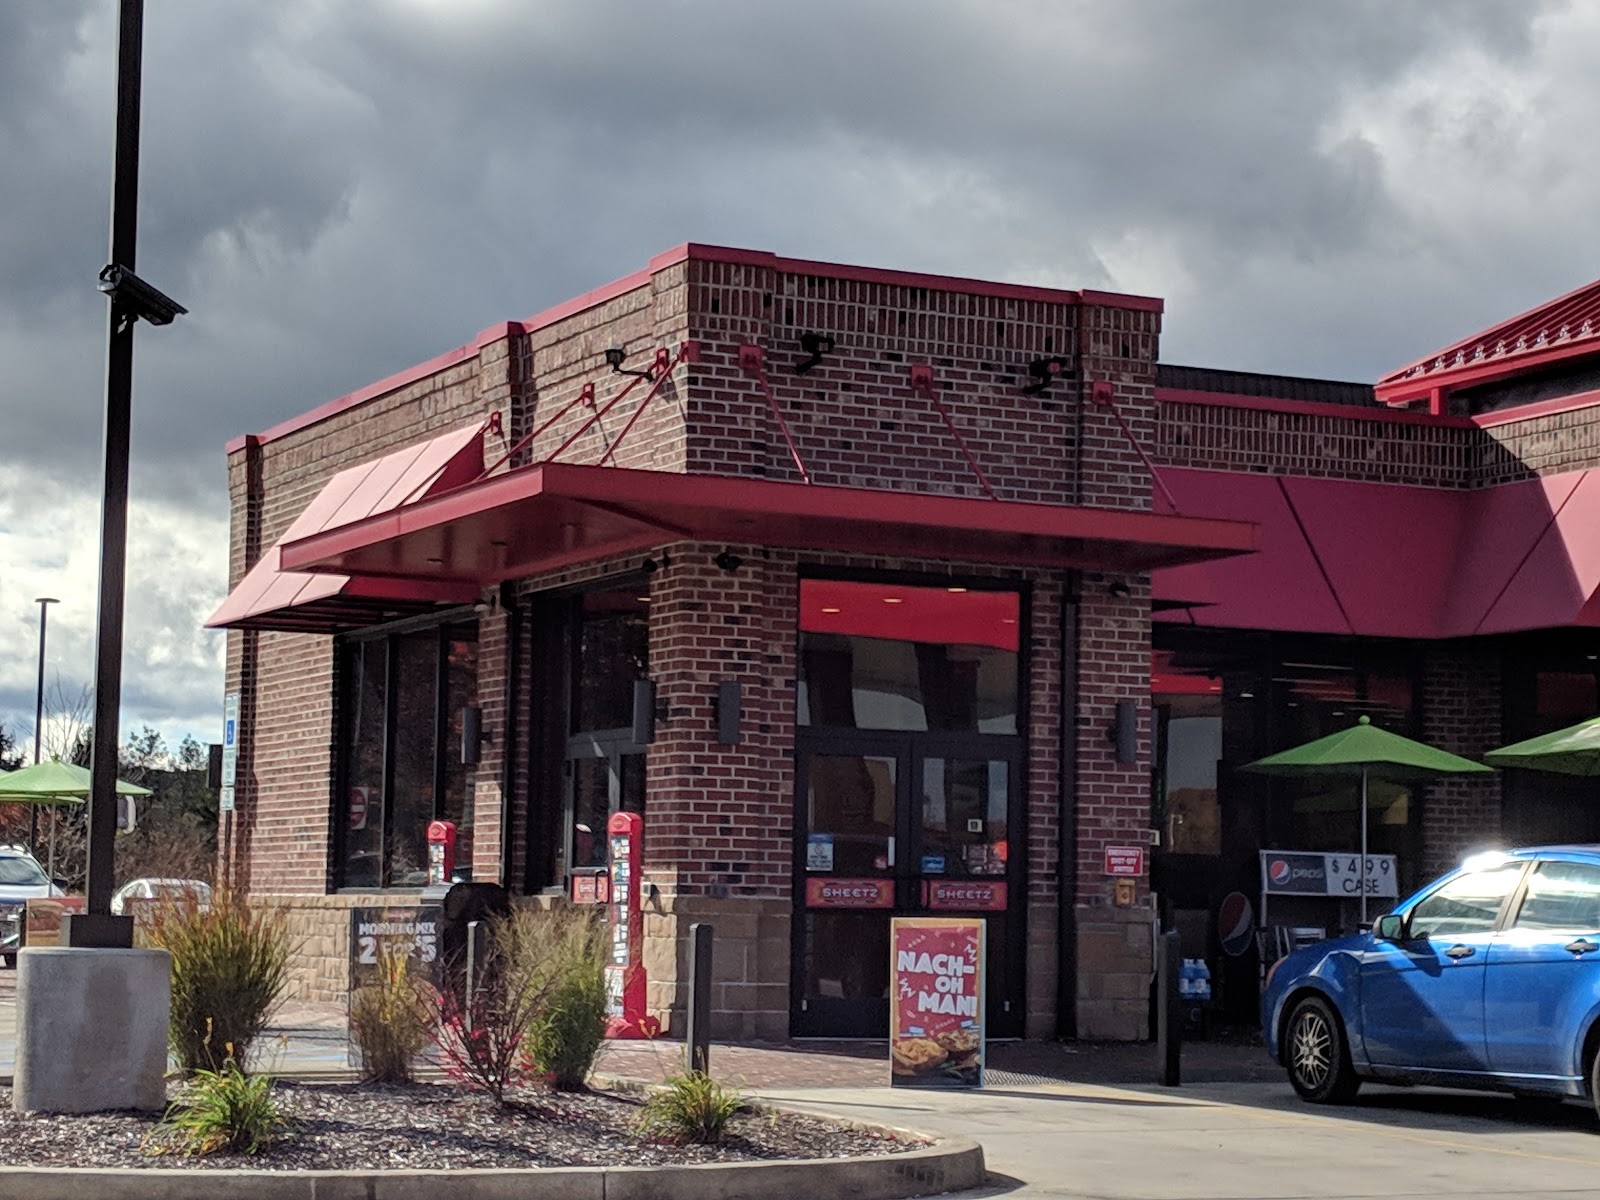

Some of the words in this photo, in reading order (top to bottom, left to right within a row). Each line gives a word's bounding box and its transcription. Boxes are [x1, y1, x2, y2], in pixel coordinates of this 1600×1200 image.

[822, 888, 879, 898] SHEETZ
[937, 889, 993, 900] SHEETZ
[1342, 878, 1380, 894] CASE
[359, 936, 377, 964] 2
[897, 950, 975, 976] NACH-
[935, 976, 964, 994] OH
[918, 991, 978, 1017] MAN!
